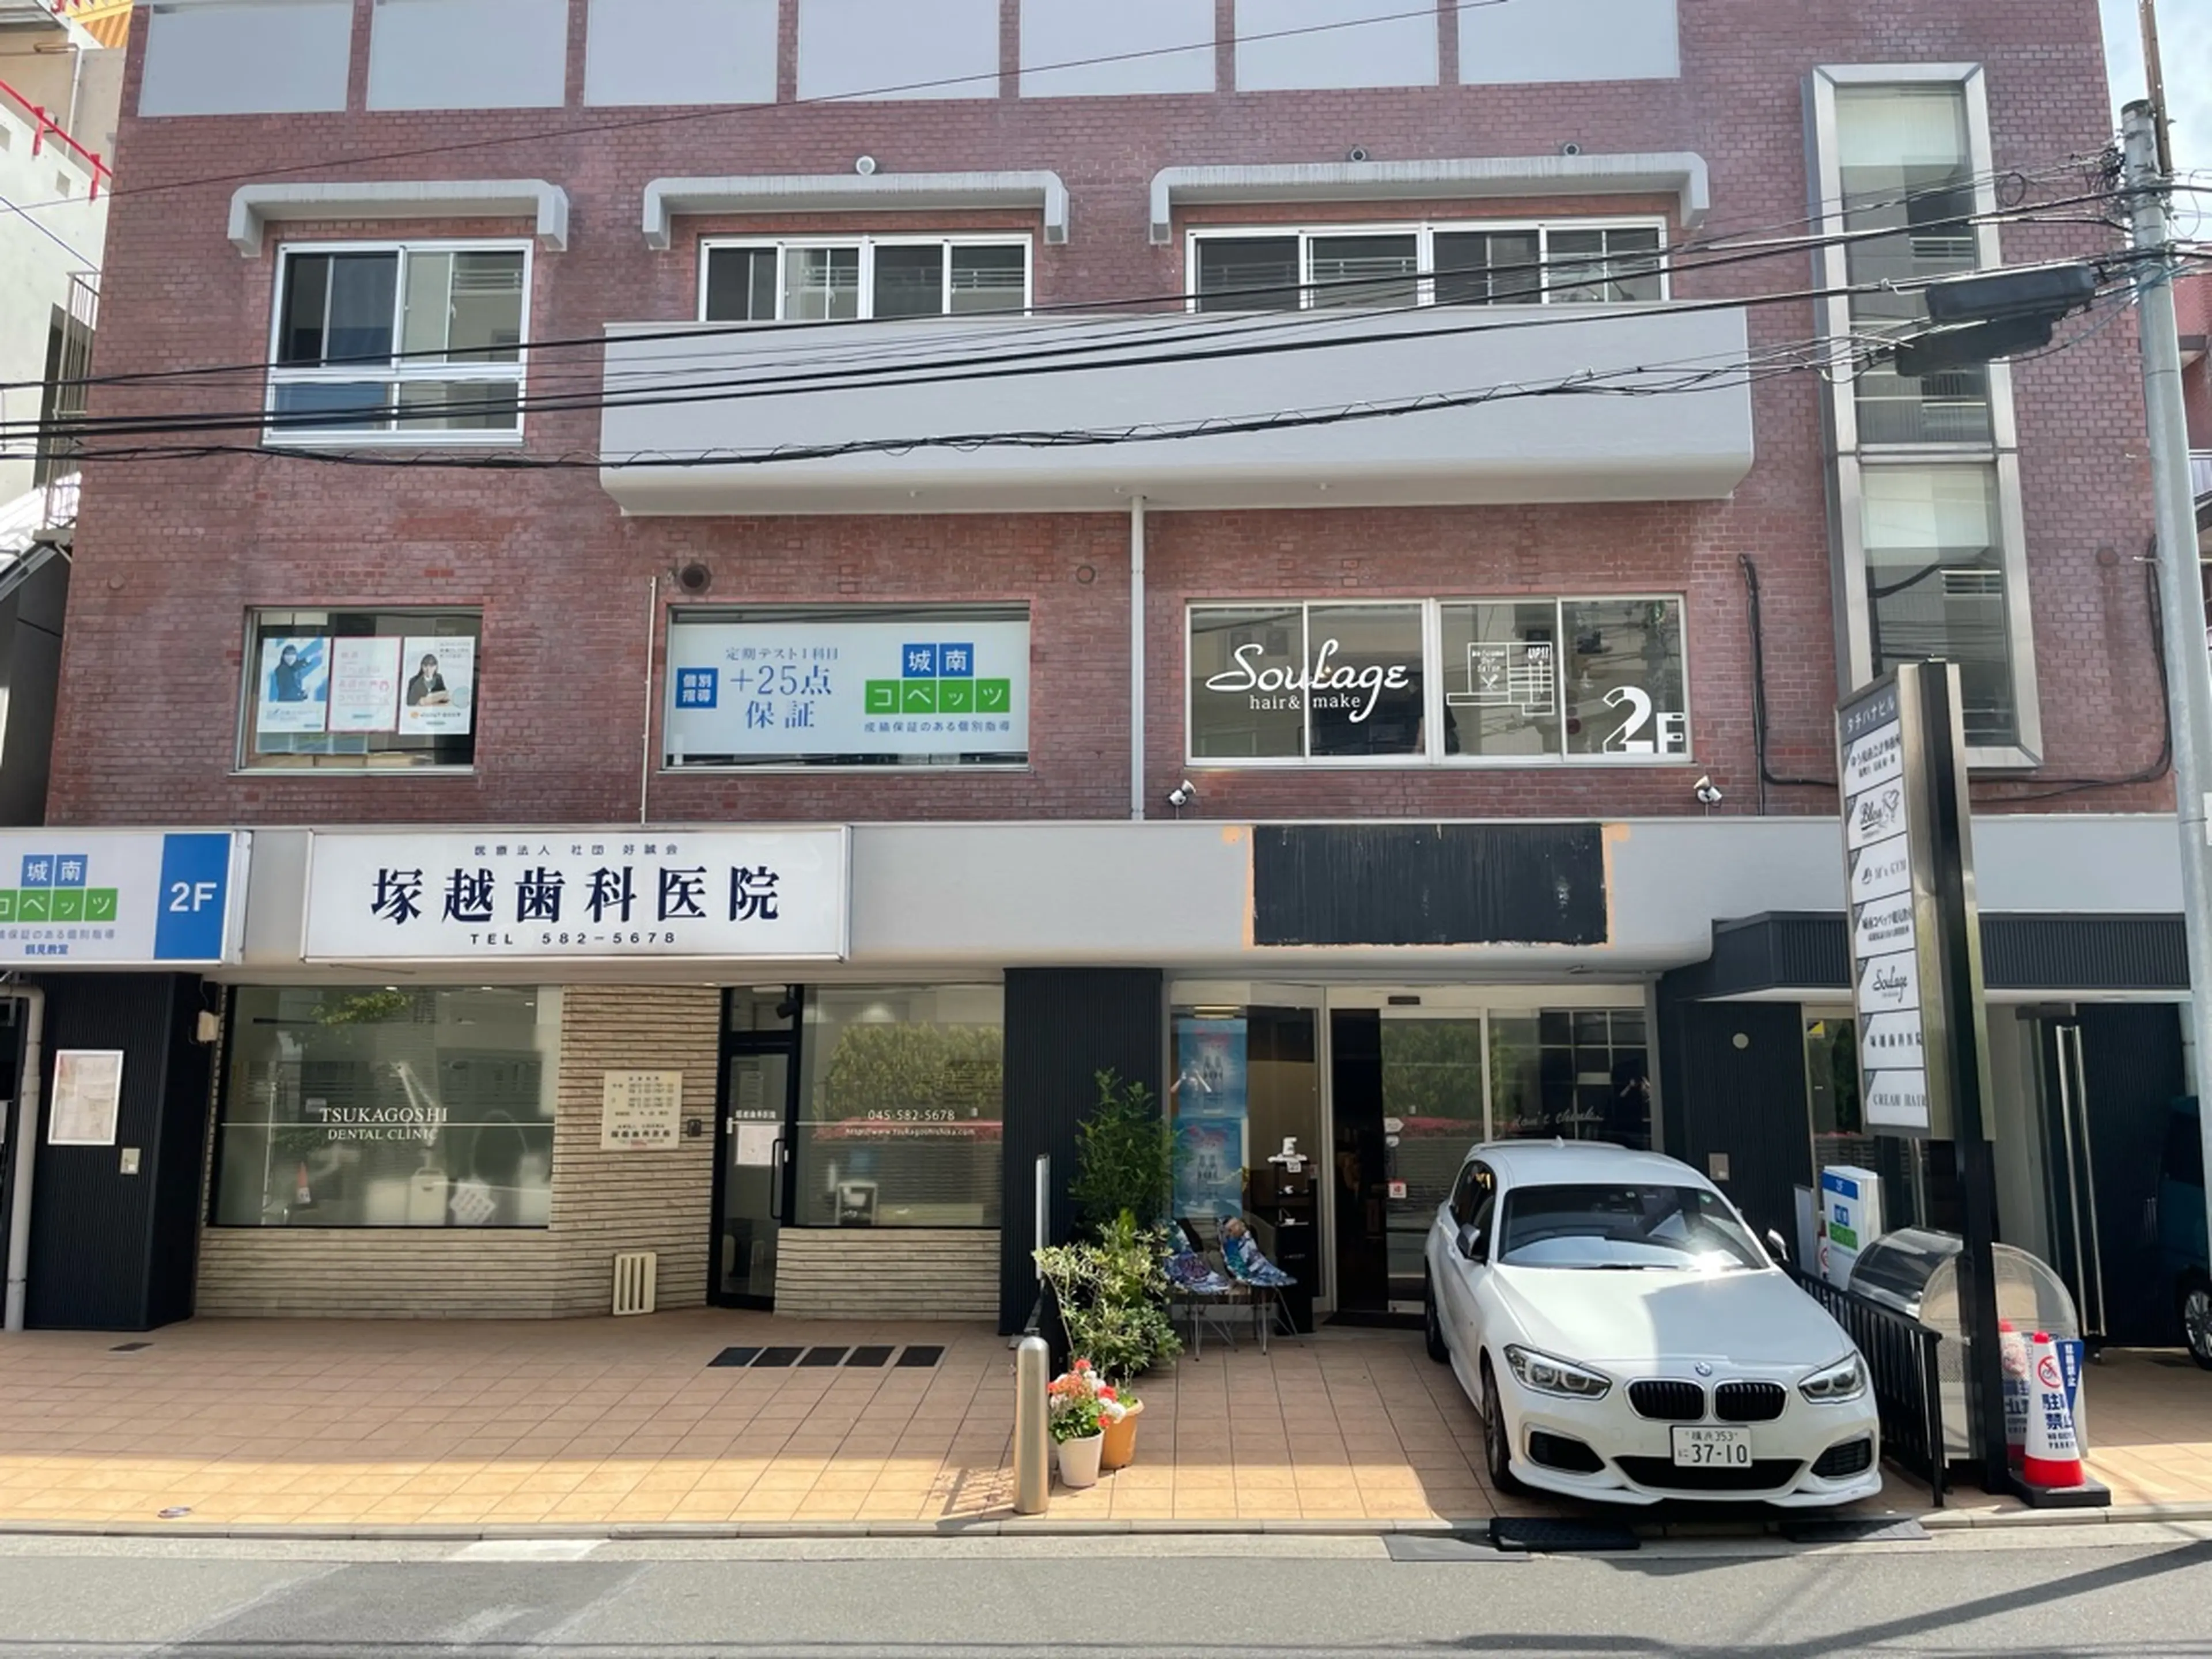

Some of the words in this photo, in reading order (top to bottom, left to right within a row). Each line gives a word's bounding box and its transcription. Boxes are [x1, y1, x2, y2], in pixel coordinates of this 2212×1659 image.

[908, 650, 969, 673] 城南
[873, 685, 1003, 706] コベッツ
[1313, 693, 1361, 708] make
[745, 701, 816, 729] 保証
[1603, 685, 1684, 753] 2F
[865, 720, 1011, 733] 成績保証のある個別指導
[474, 844, 551, 856] 医療法人
[571, 844, 605, 855] 社団
[27, 860, 82, 881] 城南
[169, 882, 218, 912] 2F
[370, 865, 779, 926] 塚越歯科医院
[469, 933, 514, 945] TEL
[541, 932, 677, 945] 582-5678
[319, 1107, 448, 1123] TSUKAGOSHI
[867, 1109, 956, 1121] 045-582-5678
[328, 1129, 383, 1140] DENTAL
[387, 1128, 438, 1140] CLINIC
[1691, 1444, 1748, 1464] 37-10
